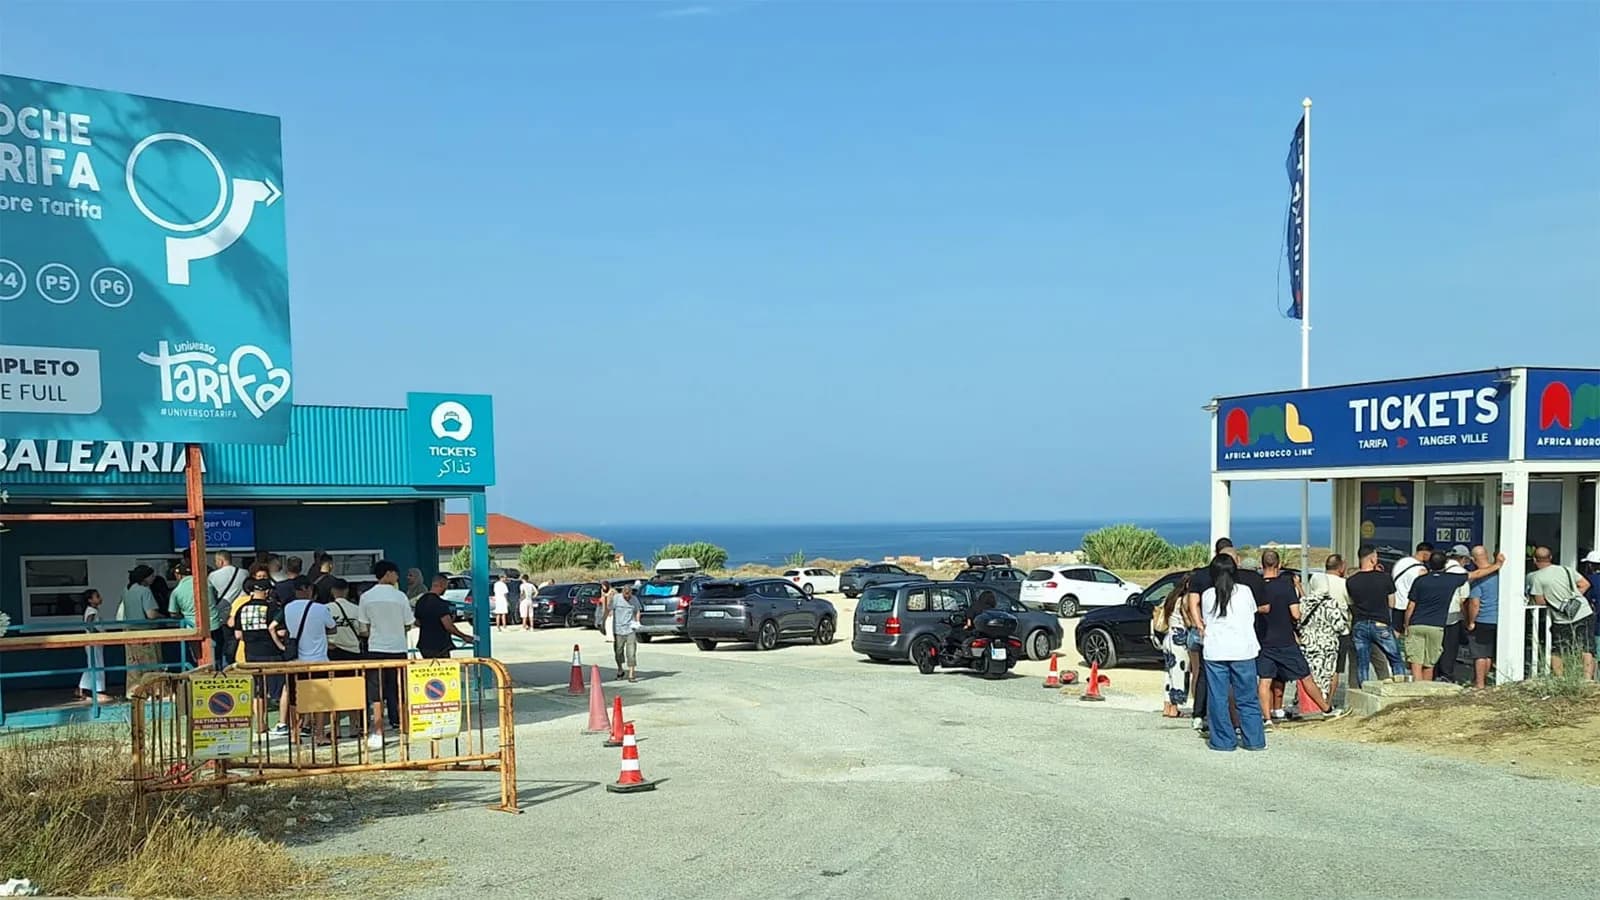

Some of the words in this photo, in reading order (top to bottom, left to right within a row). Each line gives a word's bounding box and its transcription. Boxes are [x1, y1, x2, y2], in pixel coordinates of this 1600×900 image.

[40, 198, 102, 220] Tarifa
[0, 272, 18, 288] 4
[46, 275, 71, 291] P5
[100, 279, 125, 295] P6
[0, 358, 80, 376] PLETO
[20, 383, 67, 402] FULL
[160, 407, 237, 418] #UNIVERSOTARIFA
[1349, 387, 1499, 432] TICKETS
[1358, 438, 1388, 449] TARIFA
[1418, 434, 1457, 446] TANGER
[1461, 432, 1489, 444] VILLE
[1537, 437, 1572, 446] AFRICA
[429, 446, 477, 457] TICKETS
[1224, 451, 1251, 460] AFRICA
[1253, 449, 1292, 458] MOROCCO
[437, 458, 471, 478] تذاكر
[221, 519, 241, 528] Ville
[1438, 529, 1450, 541] 12
[1457, 529, 1470, 541] 00
